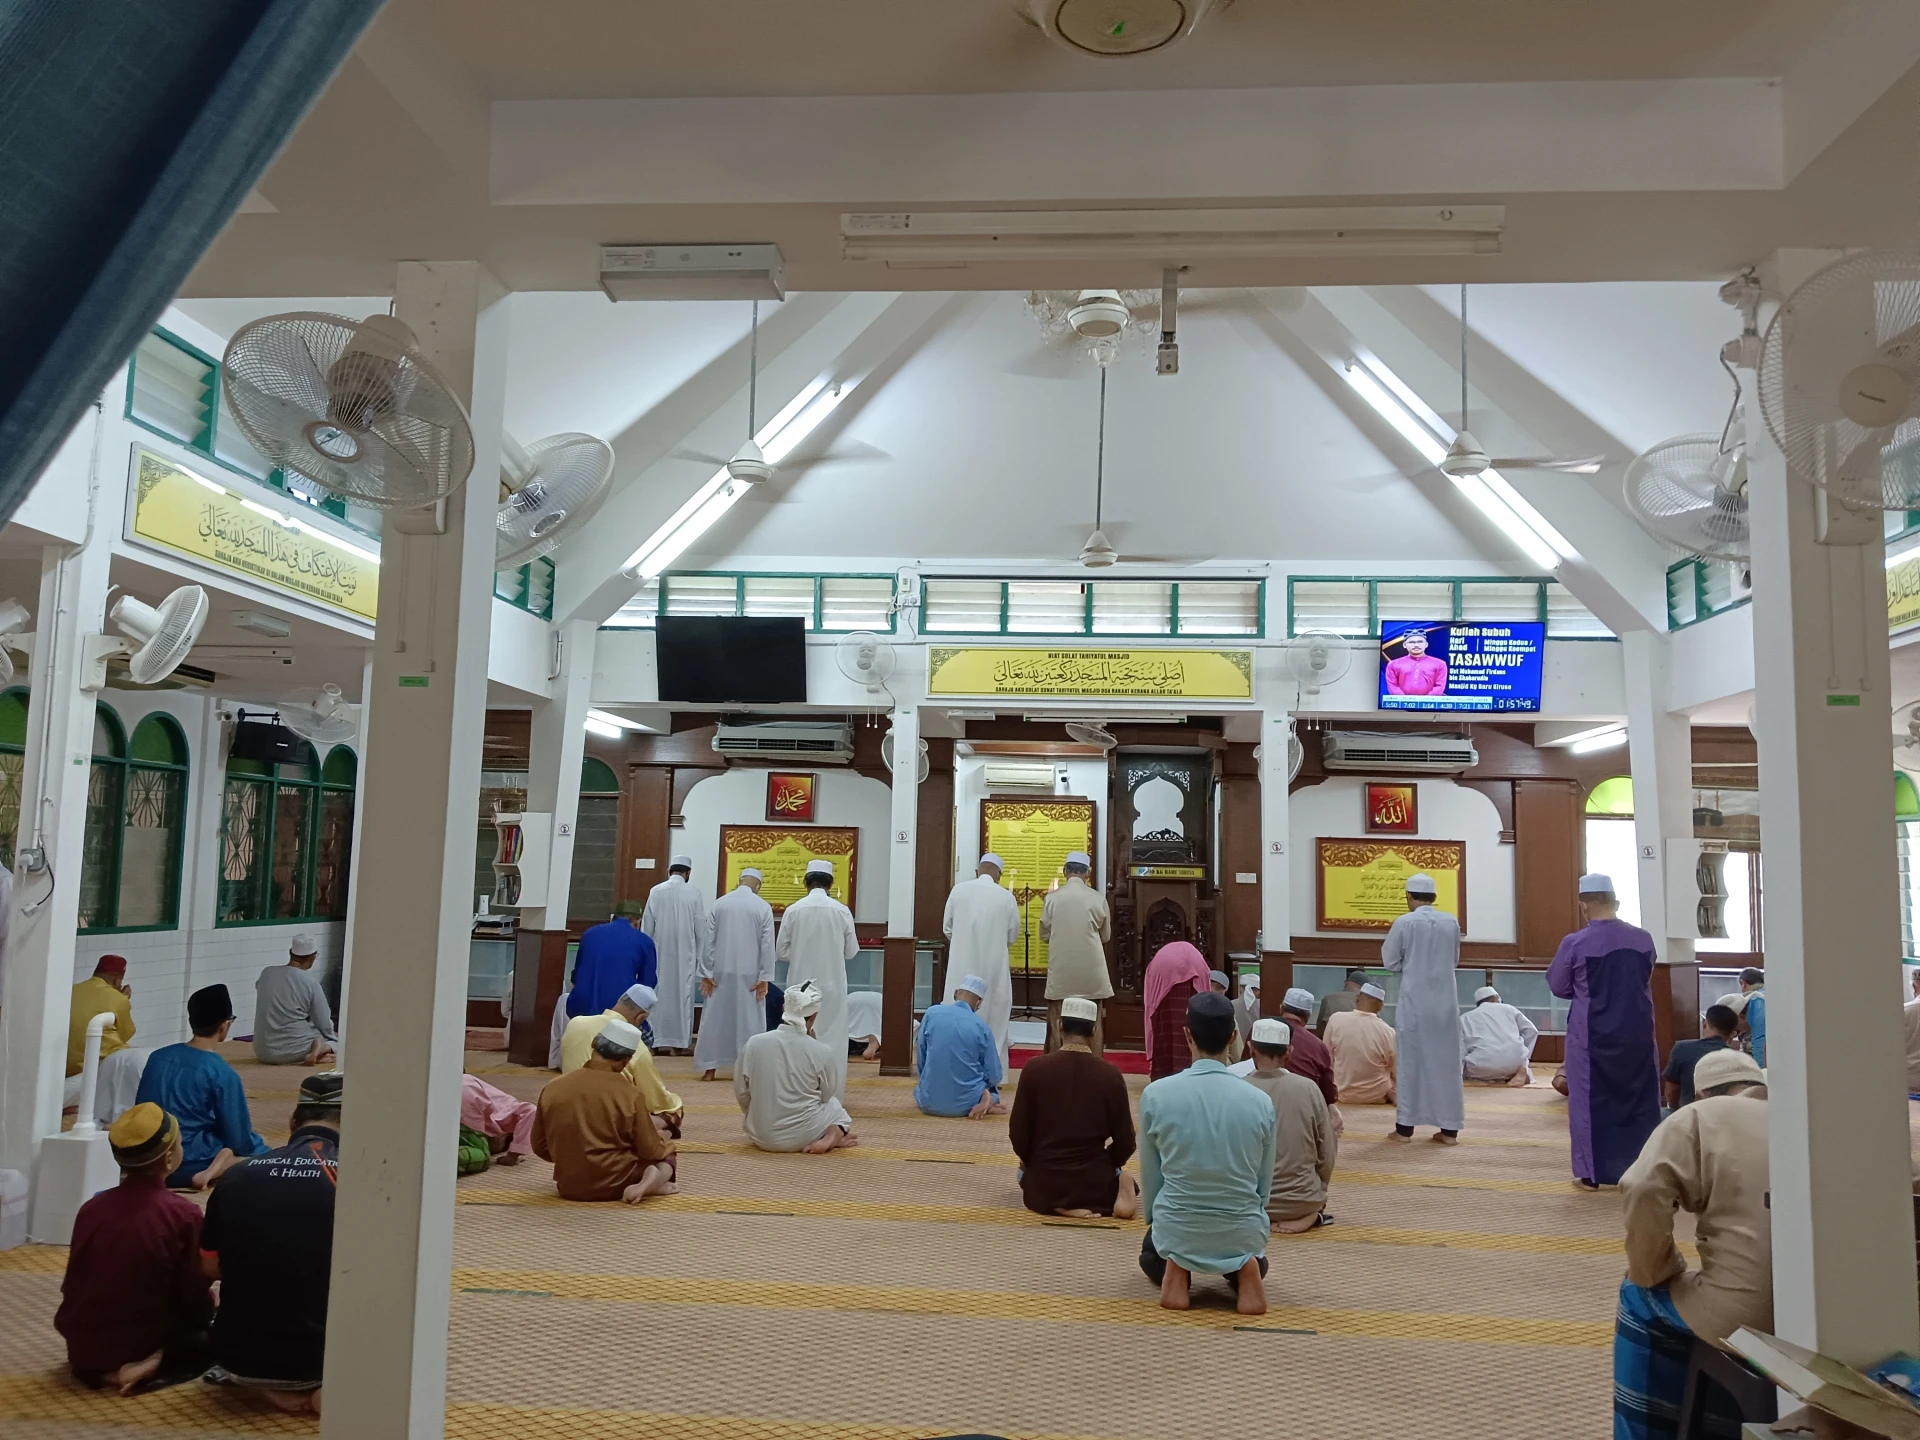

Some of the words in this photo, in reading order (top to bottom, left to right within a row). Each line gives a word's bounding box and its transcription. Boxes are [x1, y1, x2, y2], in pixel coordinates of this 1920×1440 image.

[232, 556, 242, 566] AKU
[271, 571, 285, 582] DALAM
[1450, 627, 1480, 636] Kuliah
[1482, 628, 1511, 636] Subuh
[1449, 653, 1524, 667] TASAWWUF
[1498, 699, 1532, 709] 01:57:49
[1375, 792, 1407, 824] الله
[248, 1157, 292, 1166] PHYSICAL
[270, 1168, 278, 1177] &
[282, 1168, 320, 1178] HEALTH
